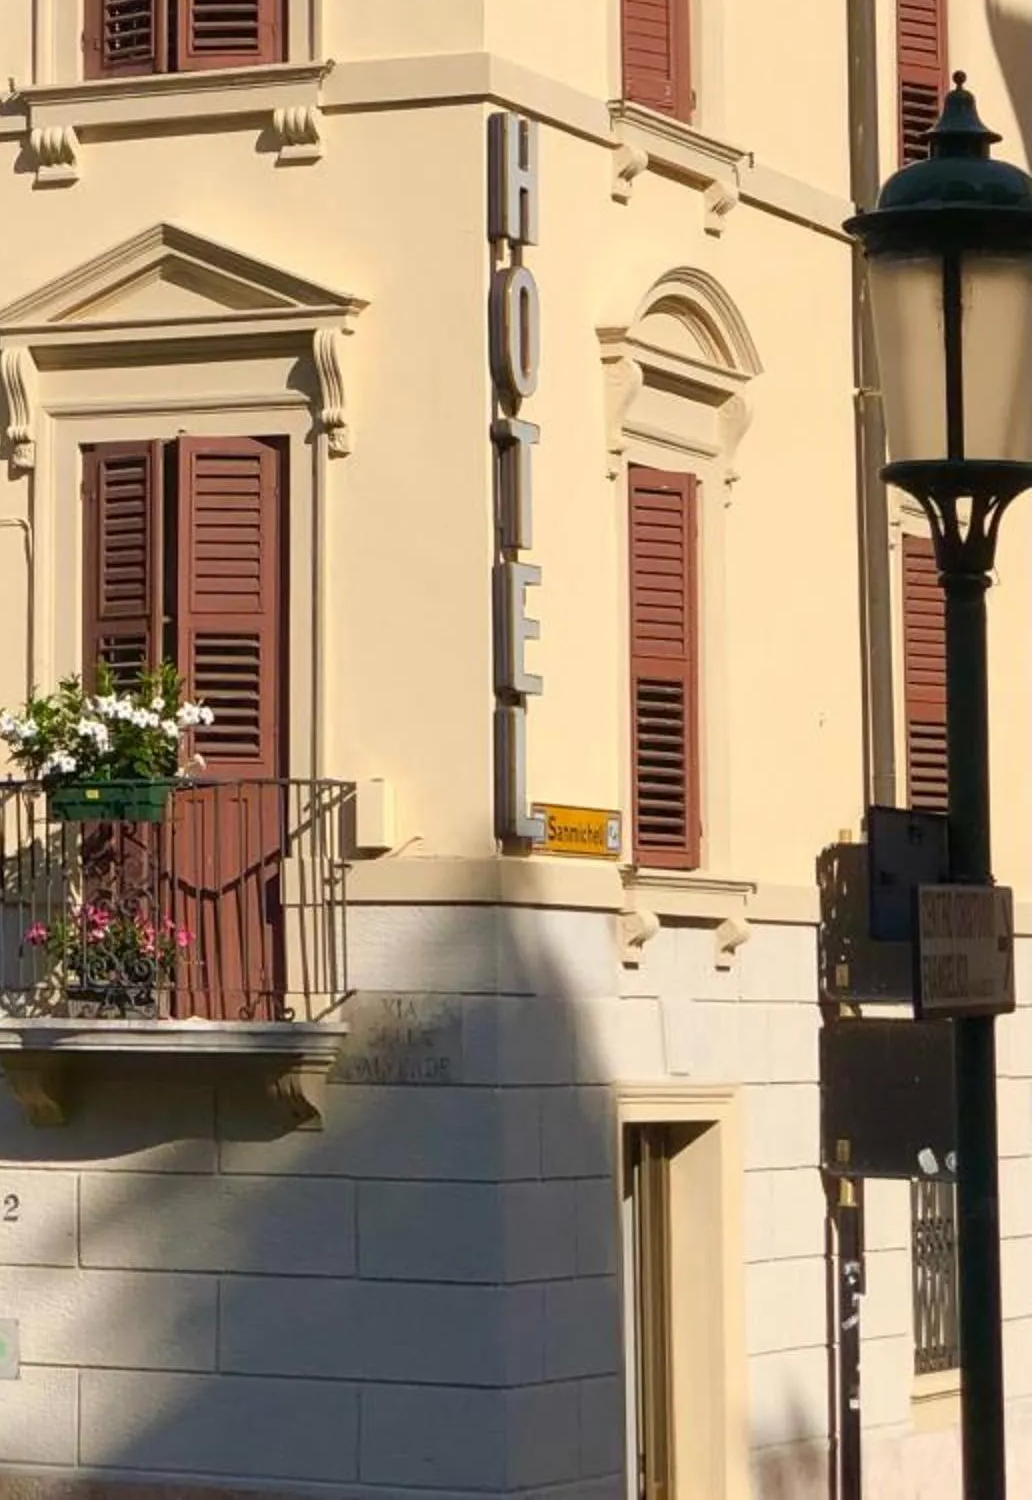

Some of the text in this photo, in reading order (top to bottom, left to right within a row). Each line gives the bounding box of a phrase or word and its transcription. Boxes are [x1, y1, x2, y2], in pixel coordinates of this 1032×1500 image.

[490, 112, 545, 841] HOTEL
[381, 998, 417, 1020] VIA
[3, 1194, 19, 1221] 2
